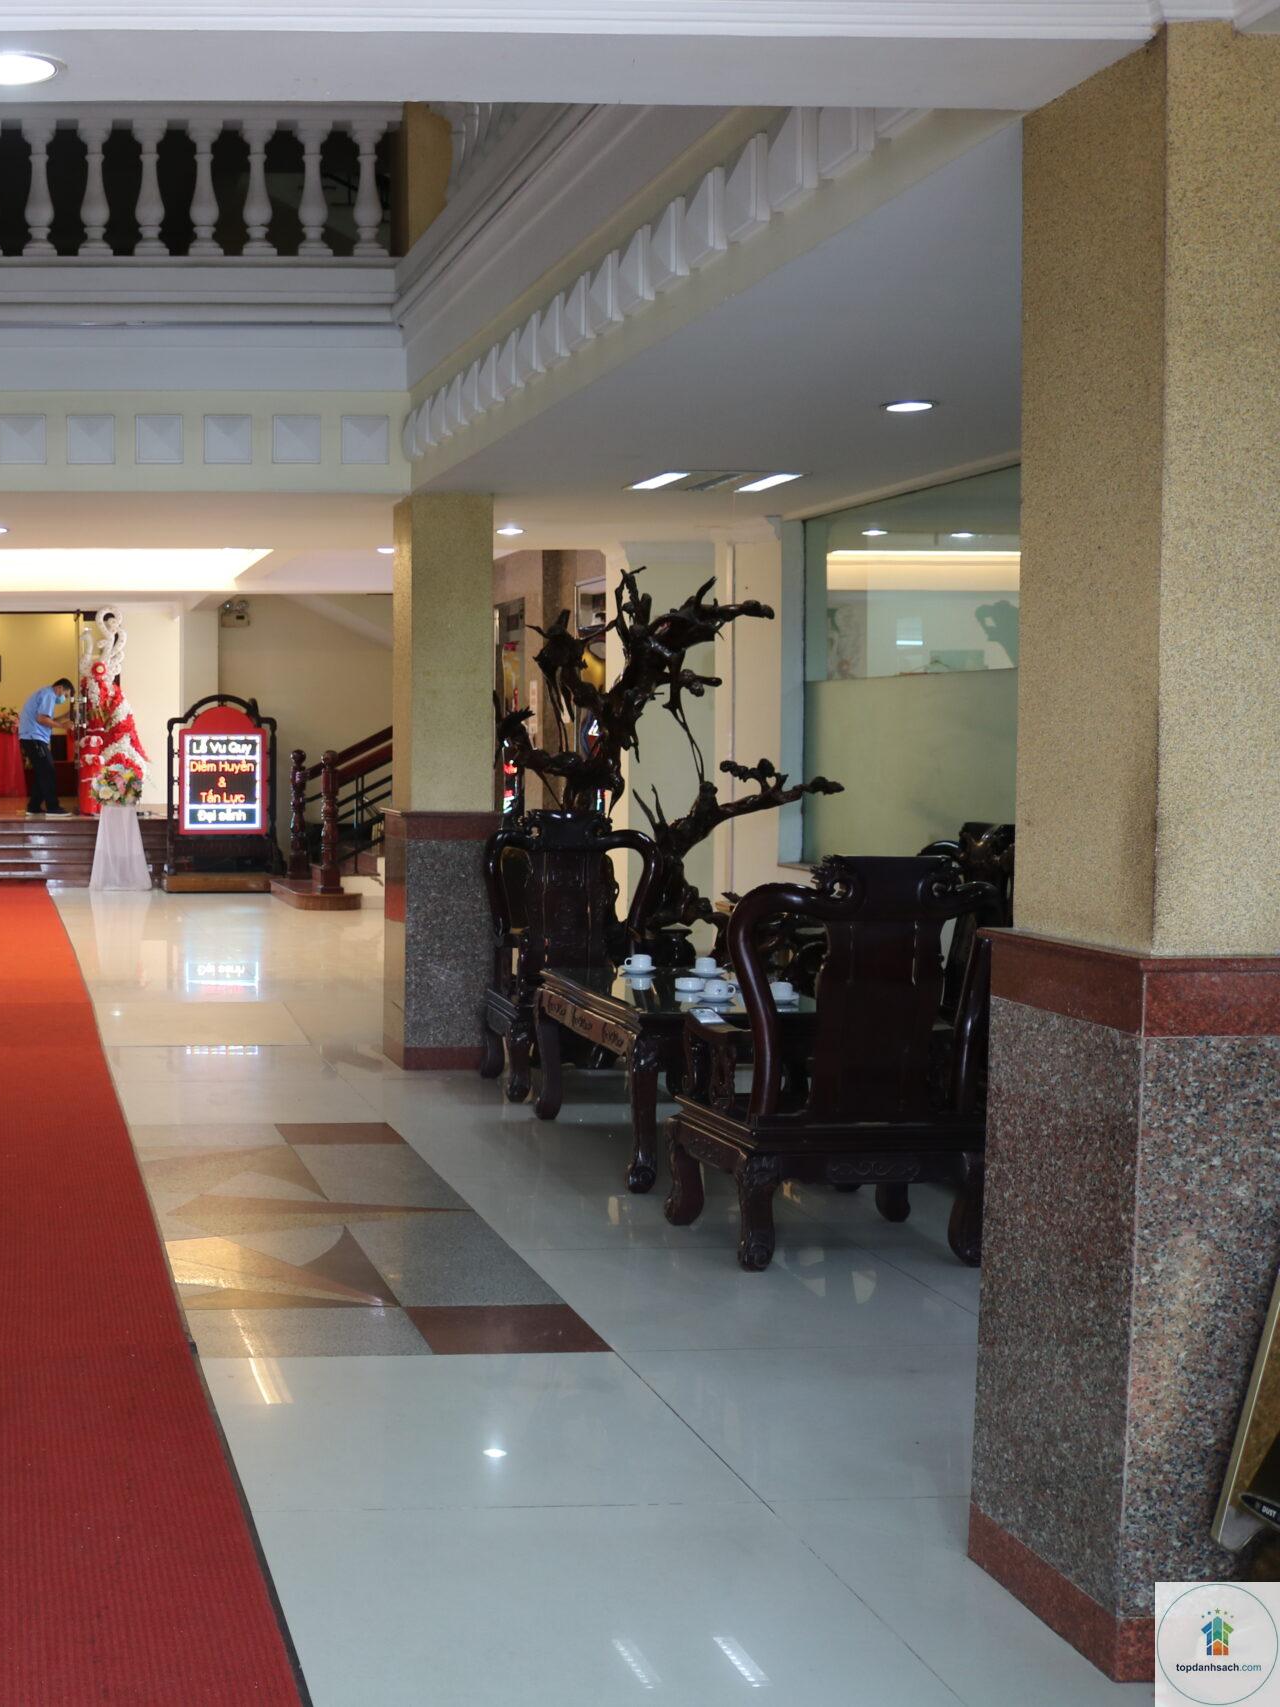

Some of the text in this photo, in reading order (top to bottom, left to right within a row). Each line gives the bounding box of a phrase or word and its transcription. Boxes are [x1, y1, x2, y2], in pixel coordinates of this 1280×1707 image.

[209, 741, 227, 754] Vu
[228, 741, 252, 756] Quy
[218, 776, 227, 788] &
